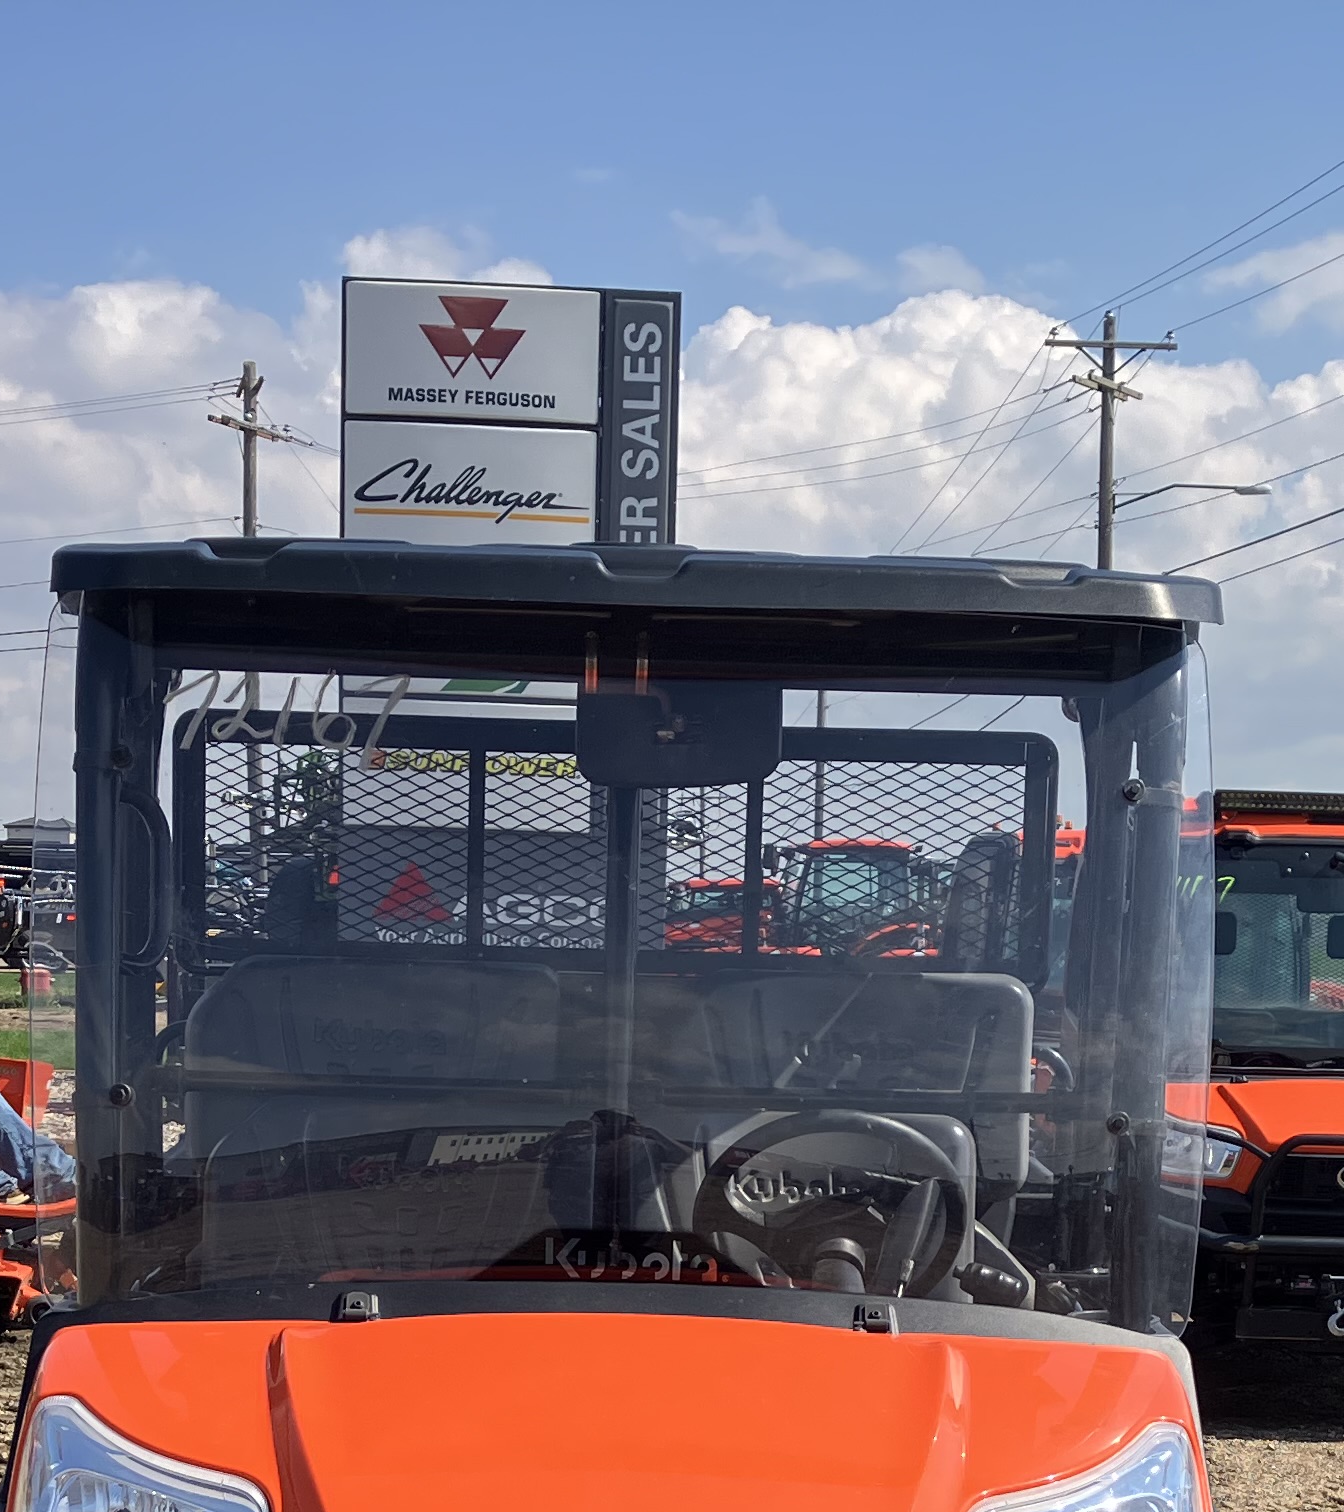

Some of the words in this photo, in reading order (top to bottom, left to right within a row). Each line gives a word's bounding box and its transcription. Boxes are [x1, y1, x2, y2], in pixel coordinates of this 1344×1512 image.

[388, 387, 458, 403] MASSEY
[465, 390, 555, 409] FERGUSON
[620, 322, 662, 480] SALES
[354, 458, 589, 524] Challenger
[386, 750, 576, 779] SUNFOWER
[544, 1236, 718, 1282] Kubota
